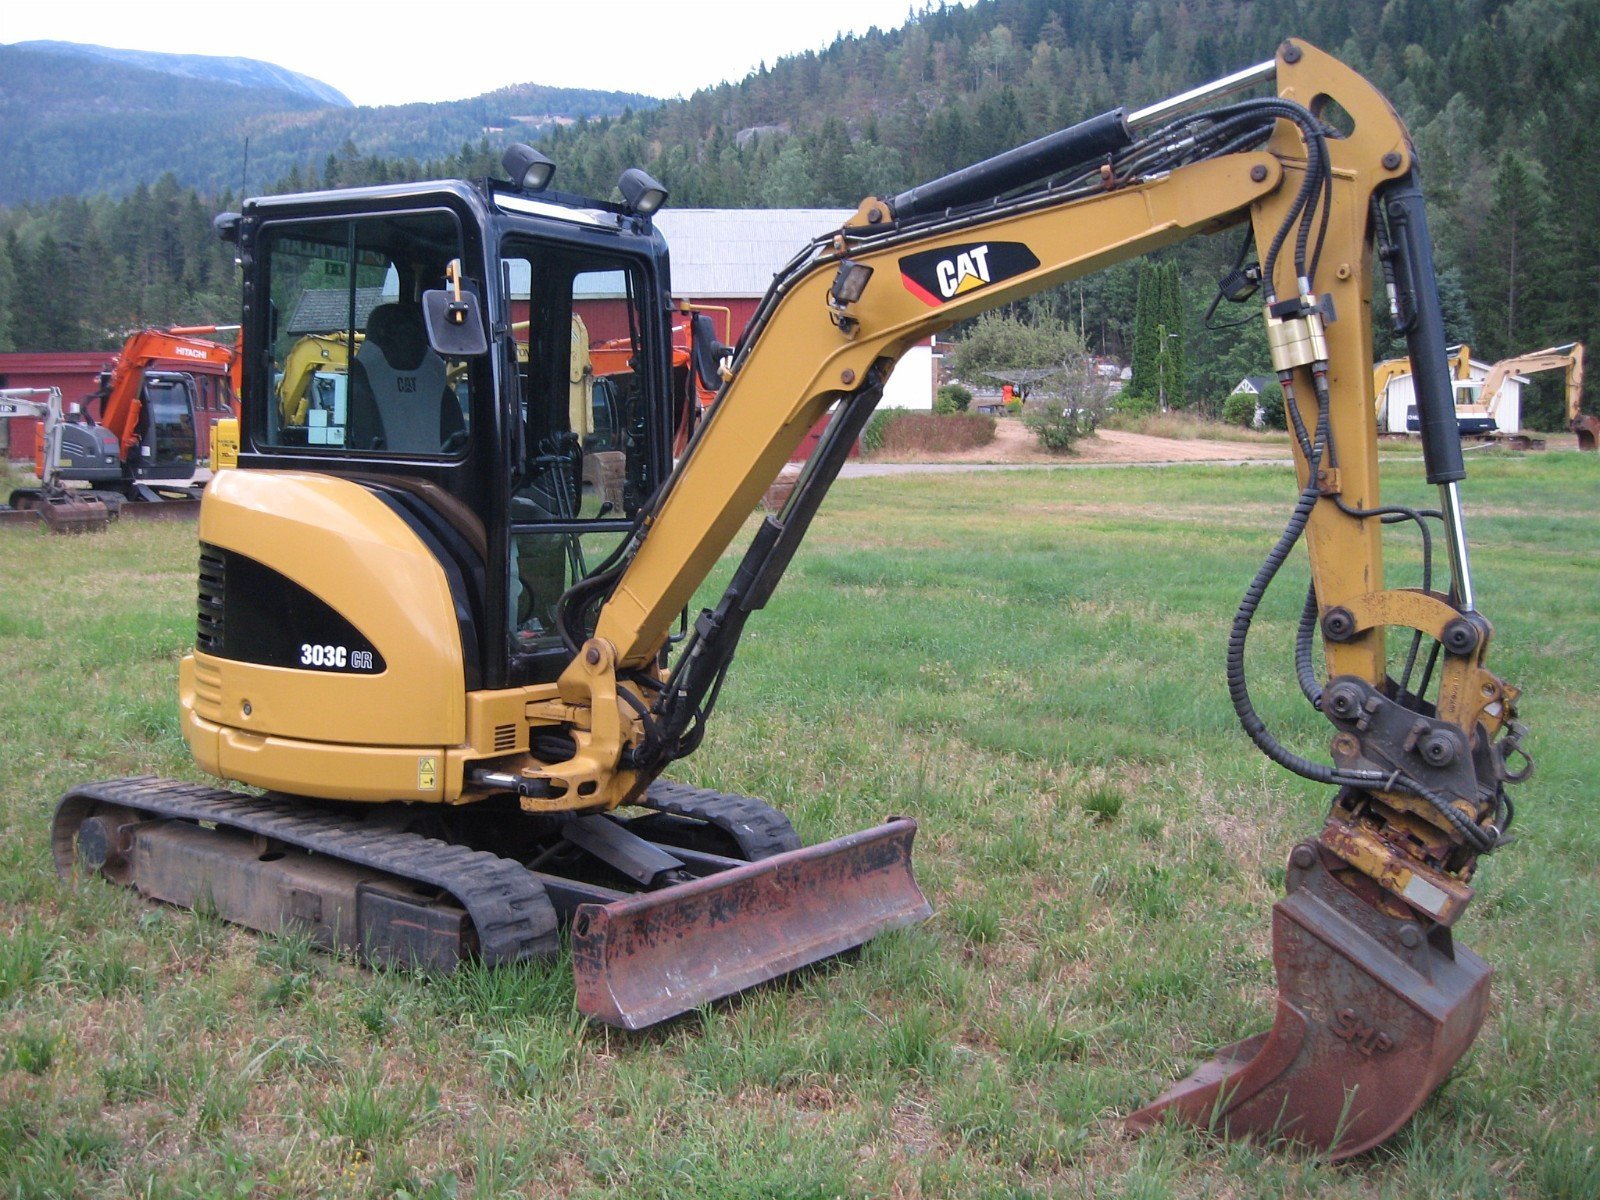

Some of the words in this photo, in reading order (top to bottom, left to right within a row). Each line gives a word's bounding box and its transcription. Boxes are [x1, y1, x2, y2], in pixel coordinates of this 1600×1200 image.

[936, 245, 991, 298] CAT
[175, 347, 207, 359] HITACHI
[397, 377, 417, 393] CAT
[301, 643, 347, 668] 303C
[351, 650, 373, 669] CR
[1328, 1008, 1393, 1057] SMP
